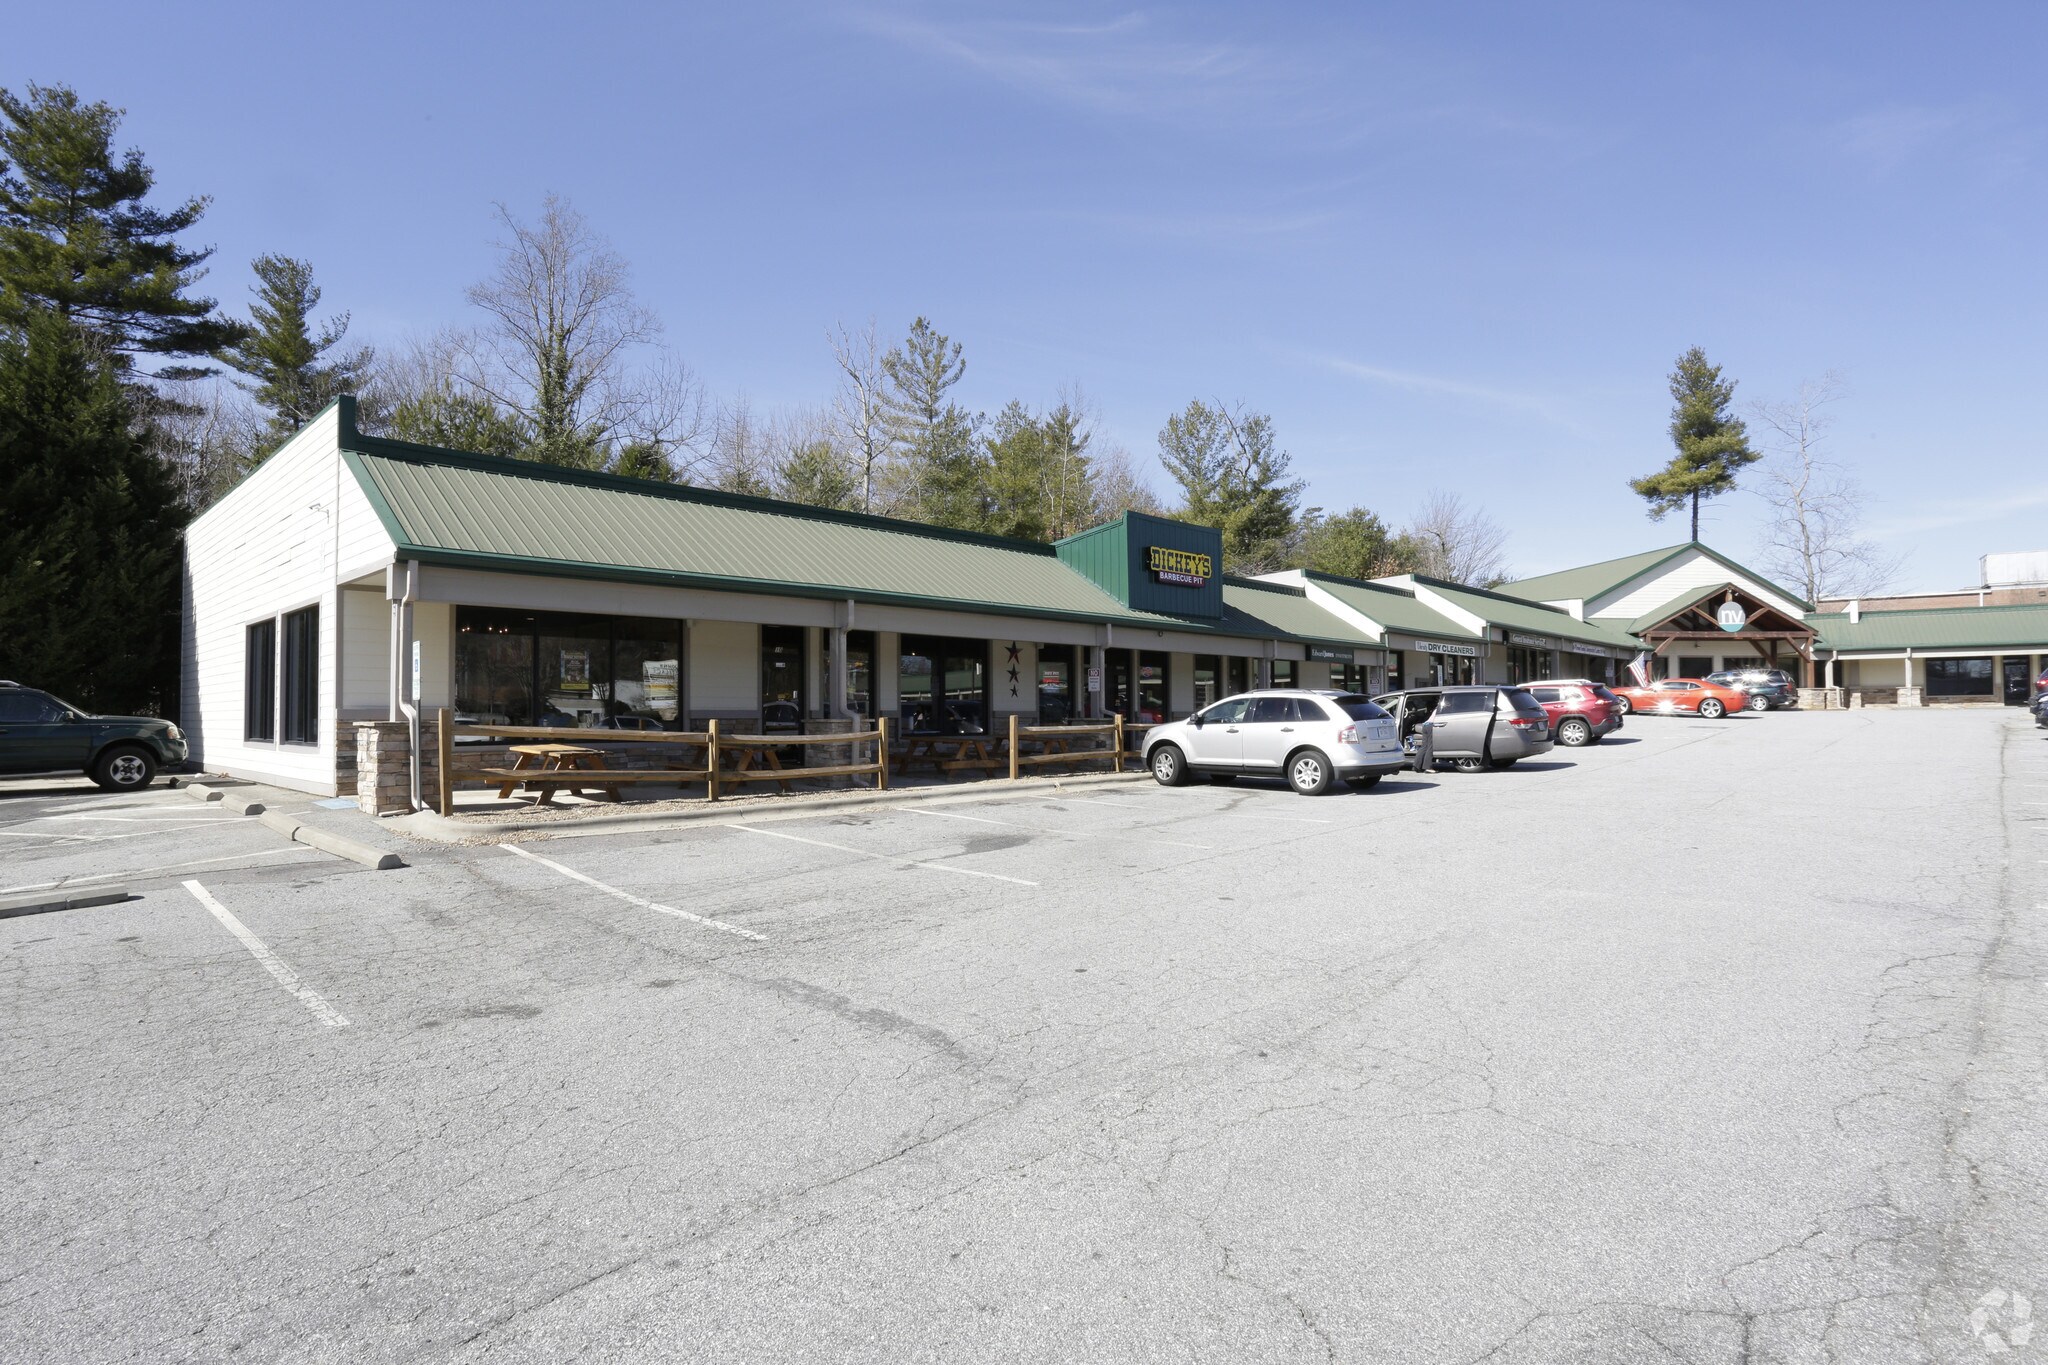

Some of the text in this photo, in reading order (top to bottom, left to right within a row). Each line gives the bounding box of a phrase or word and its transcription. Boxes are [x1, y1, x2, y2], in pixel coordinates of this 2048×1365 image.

[1152, 550, 1210, 576] DICKEY'S
[1160, 572, 1203, 585] BARBECUE PIT
[1428, 643, 1441, 651] DRY
[1441, 645, 1474, 655] CLEANERS
